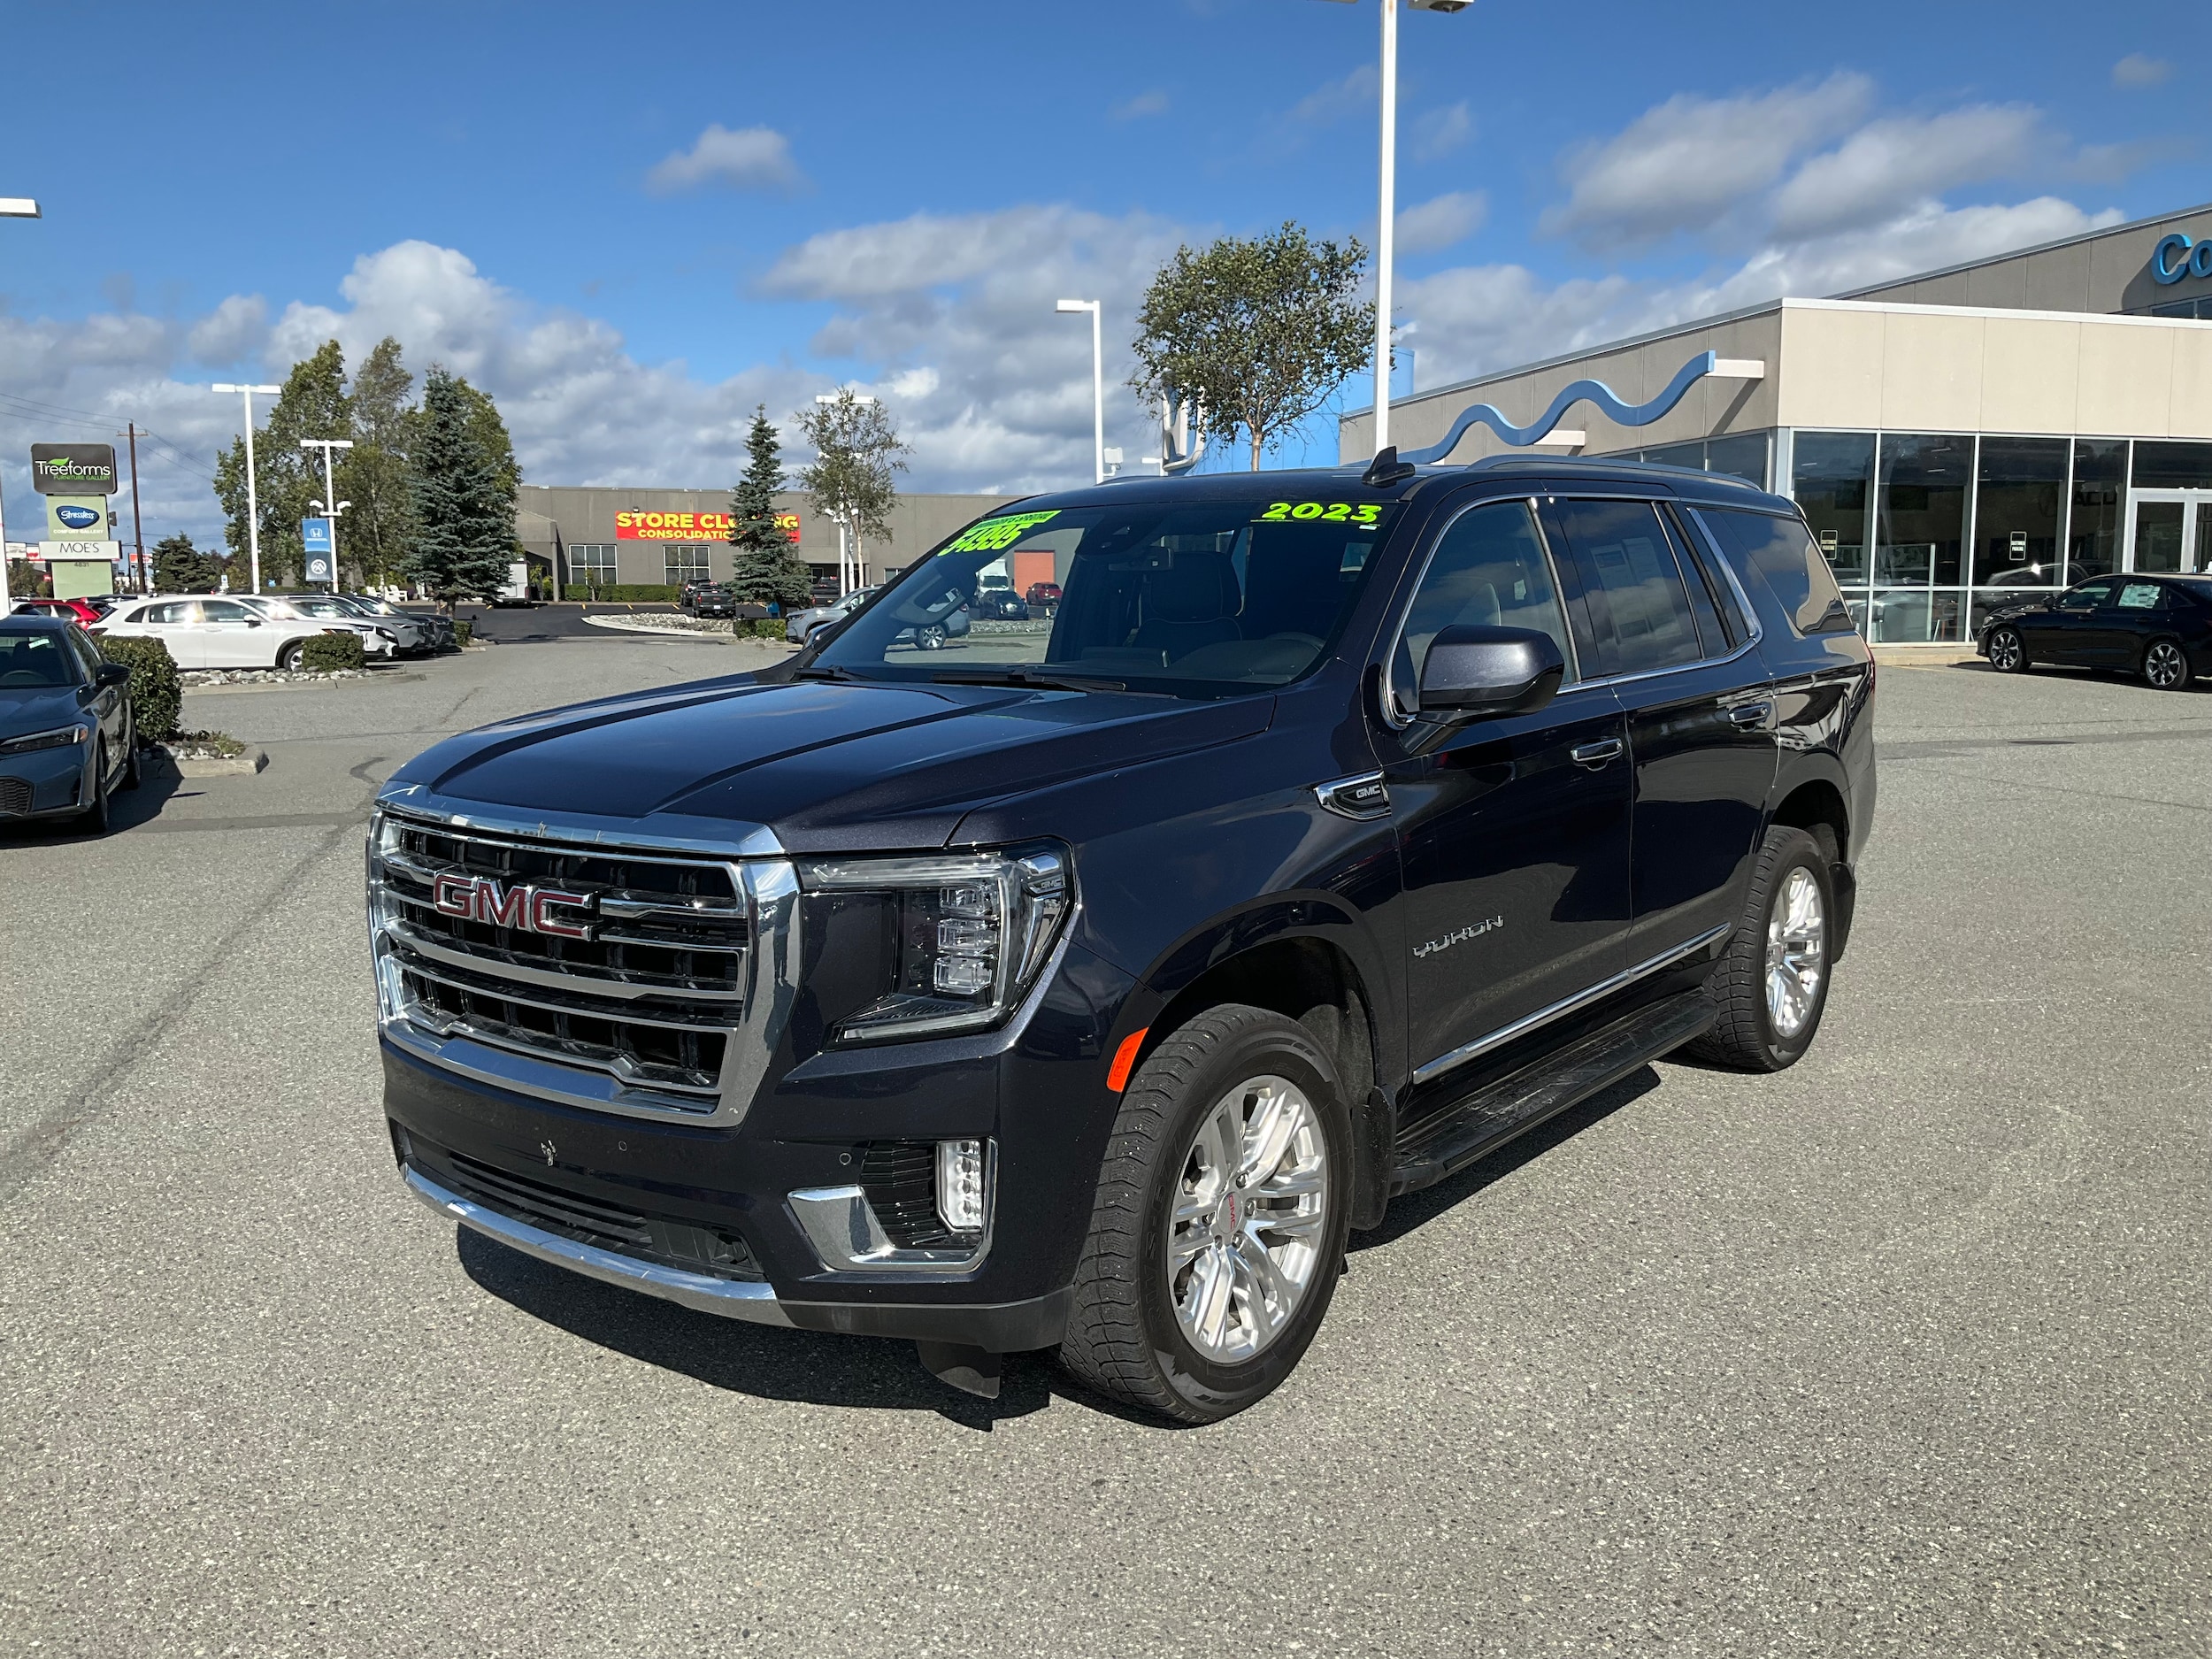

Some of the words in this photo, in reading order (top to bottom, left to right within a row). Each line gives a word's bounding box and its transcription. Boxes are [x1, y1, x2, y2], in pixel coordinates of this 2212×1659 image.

[35, 460, 111, 476] Treeforms
[61, 510, 95, 520] Stressless
[617, 512, 695, 528] STORE
[1262, 502, 1382, 523] 2023
[60, 542, 100, 553] MOE'S
[1356, 785, 1381, 799] GMC
[433, 872, 595, 941] GMC
[1412, 915, 1503, 958] YUKON
